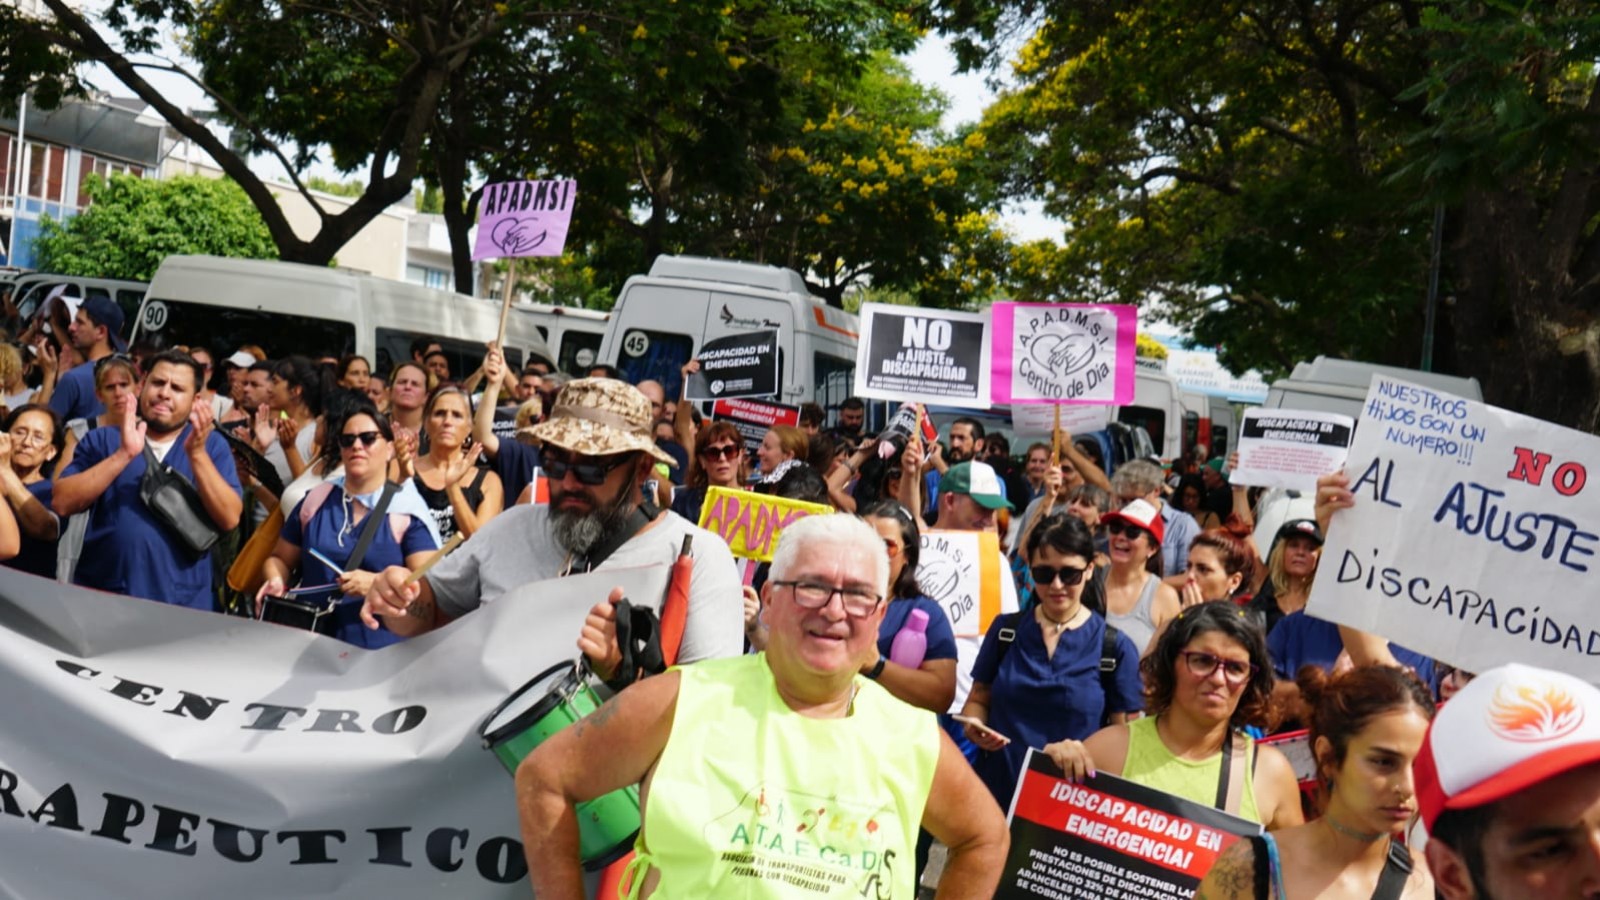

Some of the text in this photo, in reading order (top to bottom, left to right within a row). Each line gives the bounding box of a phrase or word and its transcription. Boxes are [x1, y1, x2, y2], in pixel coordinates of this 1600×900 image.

[485, 181, 570, 216] APADMSI
[145, 306, 164, 326] 90
[902, 316, 953, 351] NO
[1019, 308, 1109, 351] A.P.A.D.M.S.I.
[627, 336, 645, 352] 45
[757, 345, 770, 354] EN
[905, 349, 946, 365] AJUSTE
[705, 357, 760, 371] EMERGENCIA
[882, 359, 967, 382] DISCAPACIDAD
[1019, 357, 1062, 399] Centro
[1066, 379, 1094, 399] de
[1379, 381, 1467, 419] NUESTROS
[1262, 430, 1320, 444] EMERGENCIA!
[1320, 422, 1333, 433] EN
[1419, 414, 1454, 436] SON
[1460, 425, 1486, 442] UN
[1386, 427, 1475, 467] NUMERO!!!
[1350, 457, 1402, 508] AL
[1507, 446, 1587, 496] NO
[1434, 481, 1600, 572] AJUSTE
[56, 660, 428, 735] CENTRO
[1065, 814, 1194, 869] EMERGENCIA!
[1196, 829, 1222, 851] EN
[1017, 868, 1073, 893] ARANCELES
[1017, 879, 1029, 889] SE
[1029, 849, 1101, 880] PRESTACIONES
[1102, 874, 1117, 885] DE
[1031, 861, 1047, 873] UN
[1047, 867, 1084, 885] MAGRO
[1084, 879, 1104, 893] 32%
[1105, 886, 1120, 898] DE
[1053, 846, 1069, 857] NO
[1070, 850, 1083, 863] ES
[1083, 855, 1125, 876] POSIBLE
[1126, 870, 1177, 893] SOSTENER
